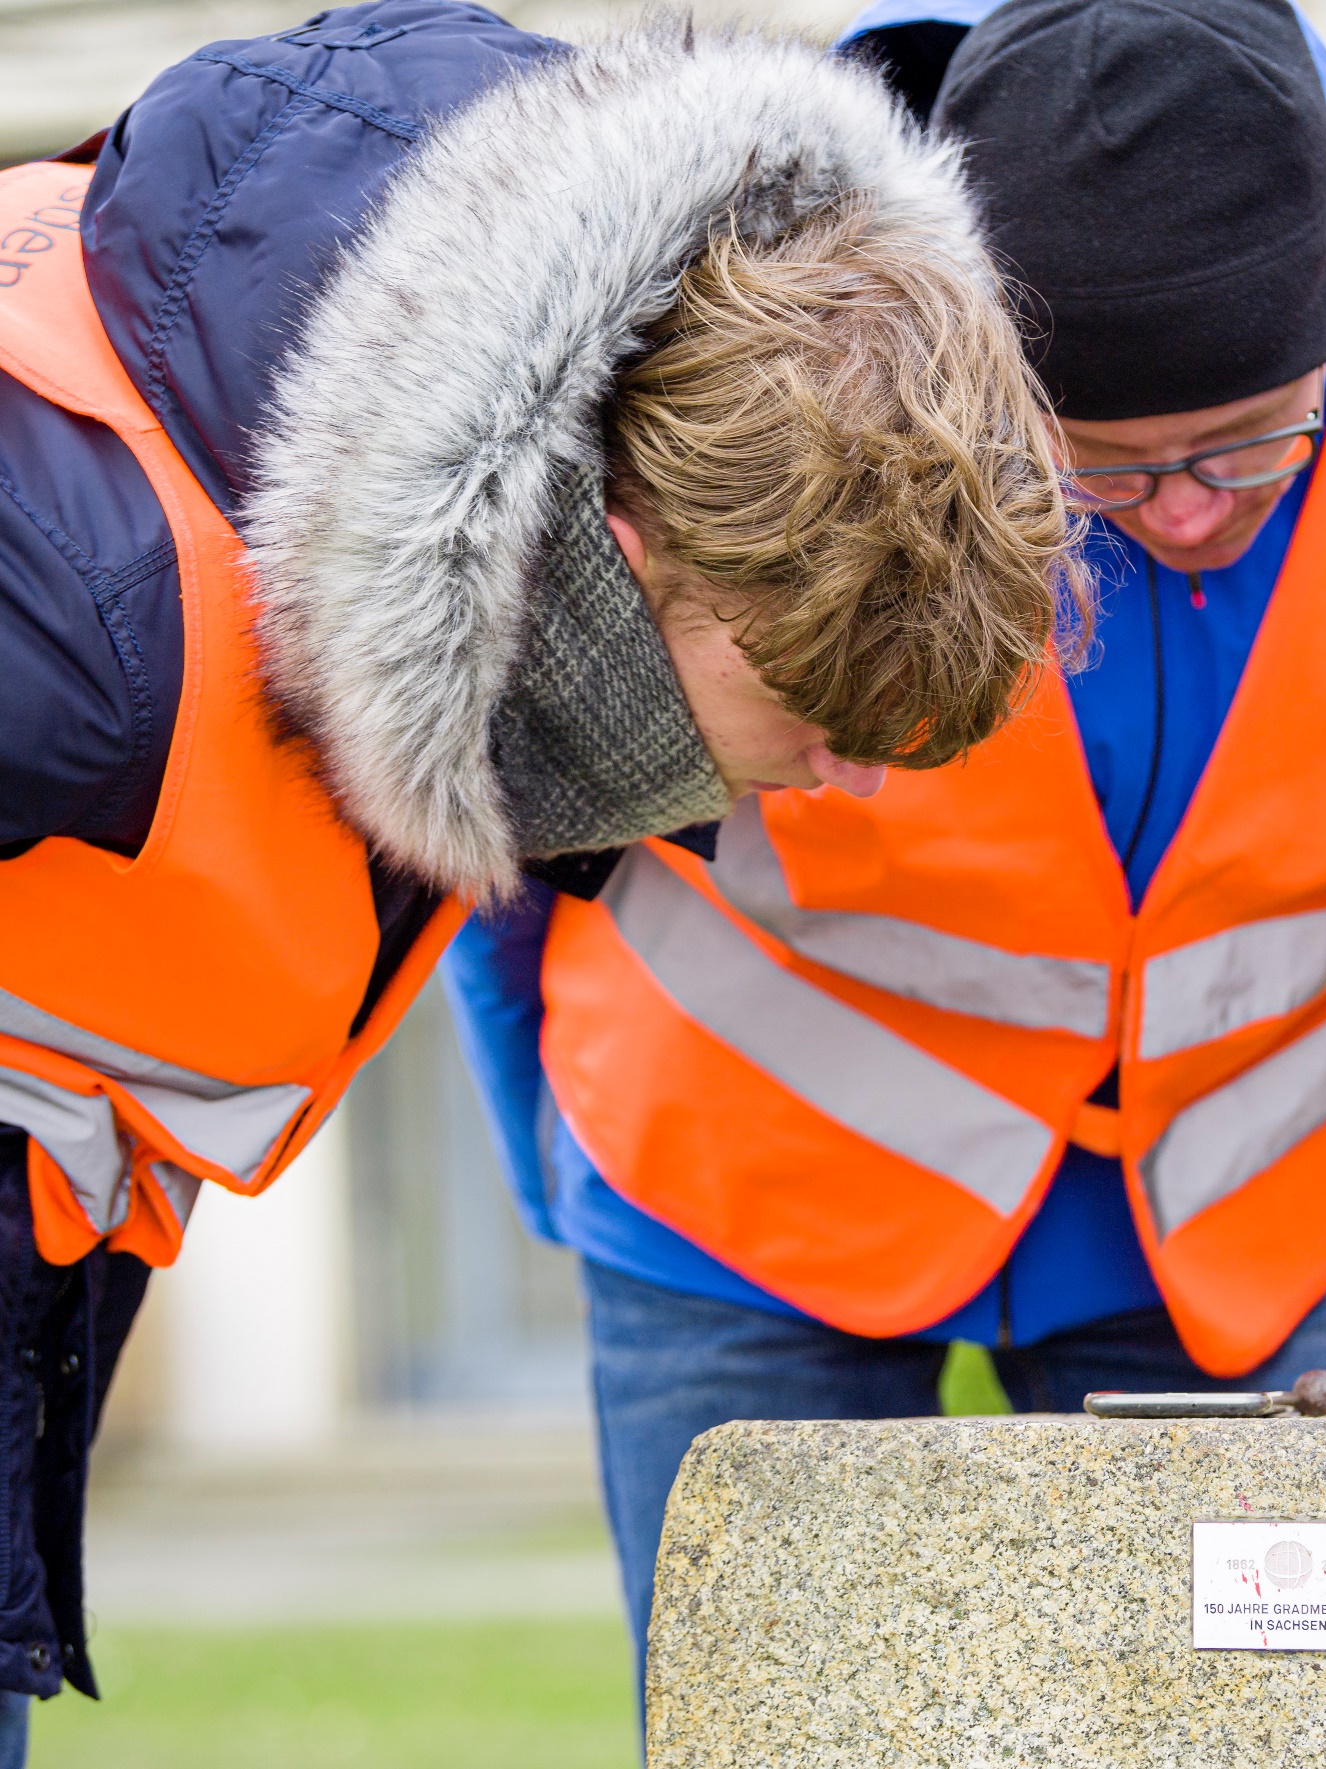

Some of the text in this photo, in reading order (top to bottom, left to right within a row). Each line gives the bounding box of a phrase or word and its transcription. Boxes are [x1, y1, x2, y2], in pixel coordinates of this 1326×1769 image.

[1226, 1559, 1255, 1570] 1862
[1204, 1603, 1224, 1614] 150
[1227, 1603, 1269, 1614] JAHRE
[1250, 1620, 1326, 1631] IN SACHSEN
